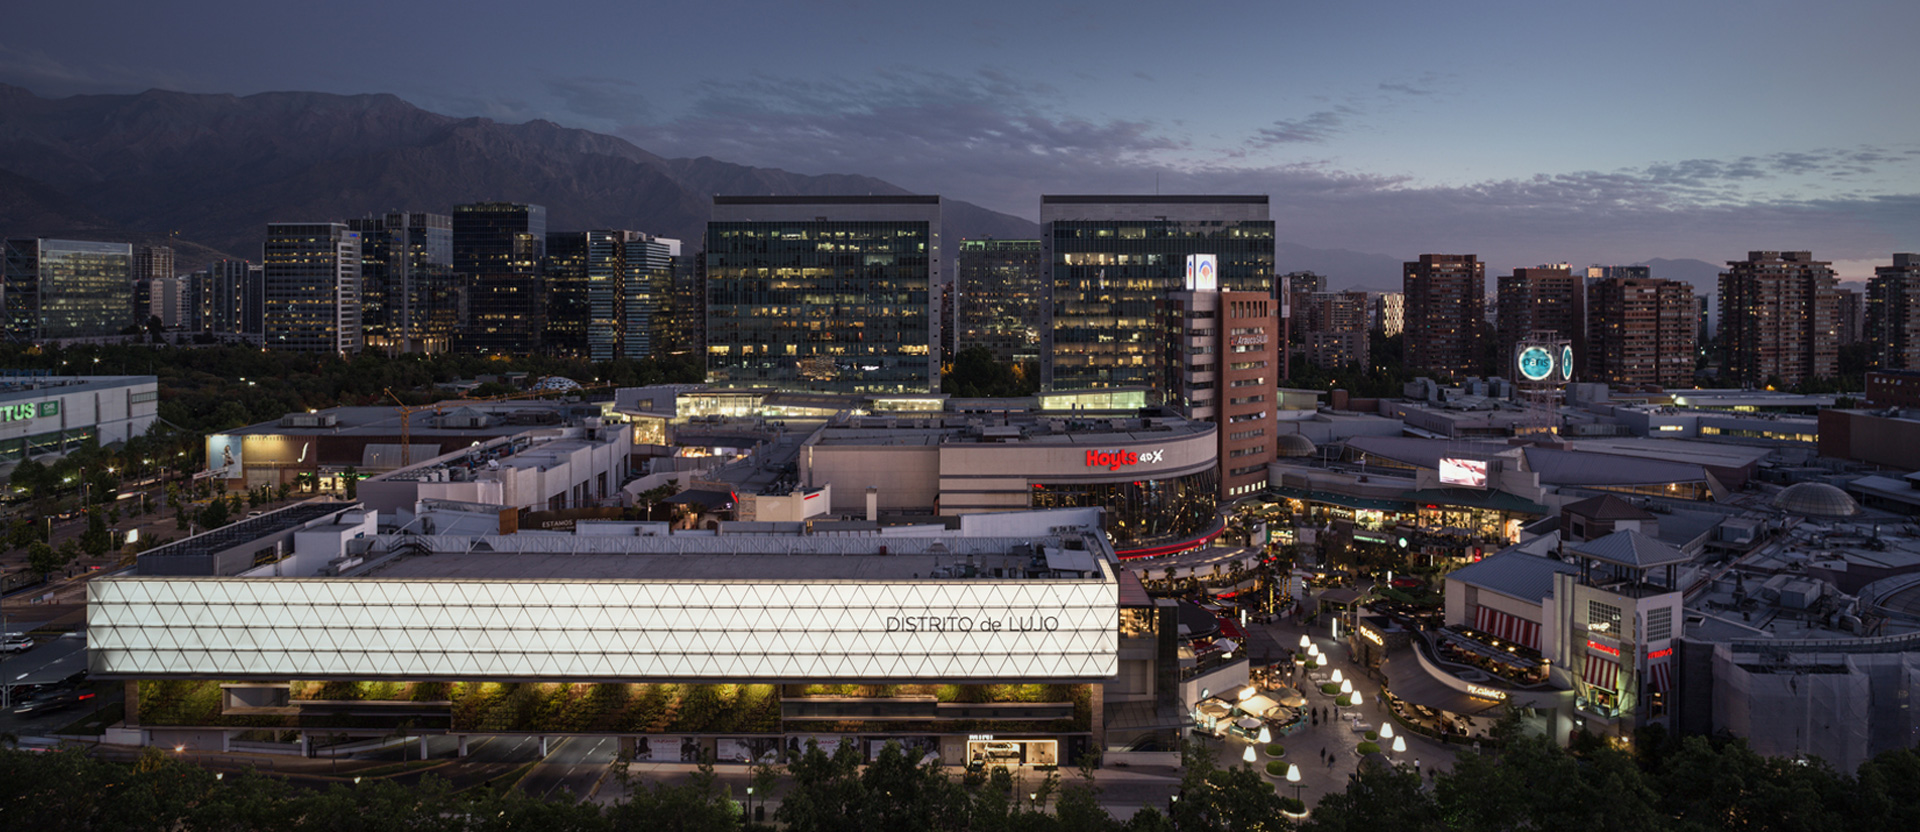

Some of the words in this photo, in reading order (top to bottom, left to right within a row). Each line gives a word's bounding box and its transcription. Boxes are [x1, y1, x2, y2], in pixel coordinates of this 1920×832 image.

[1522, 358, 1549, 367] paris
[1086, 449, 1138, 471] Hoyts
[1140, 449, 1164, 464] 4DX
[542, 519, 573, 528] ESTAMOS
[886, 616, 973, 632] DISTRITO
[980, 617, 1002, 632] de
[1009, 616, 1059, 632] LUJO
